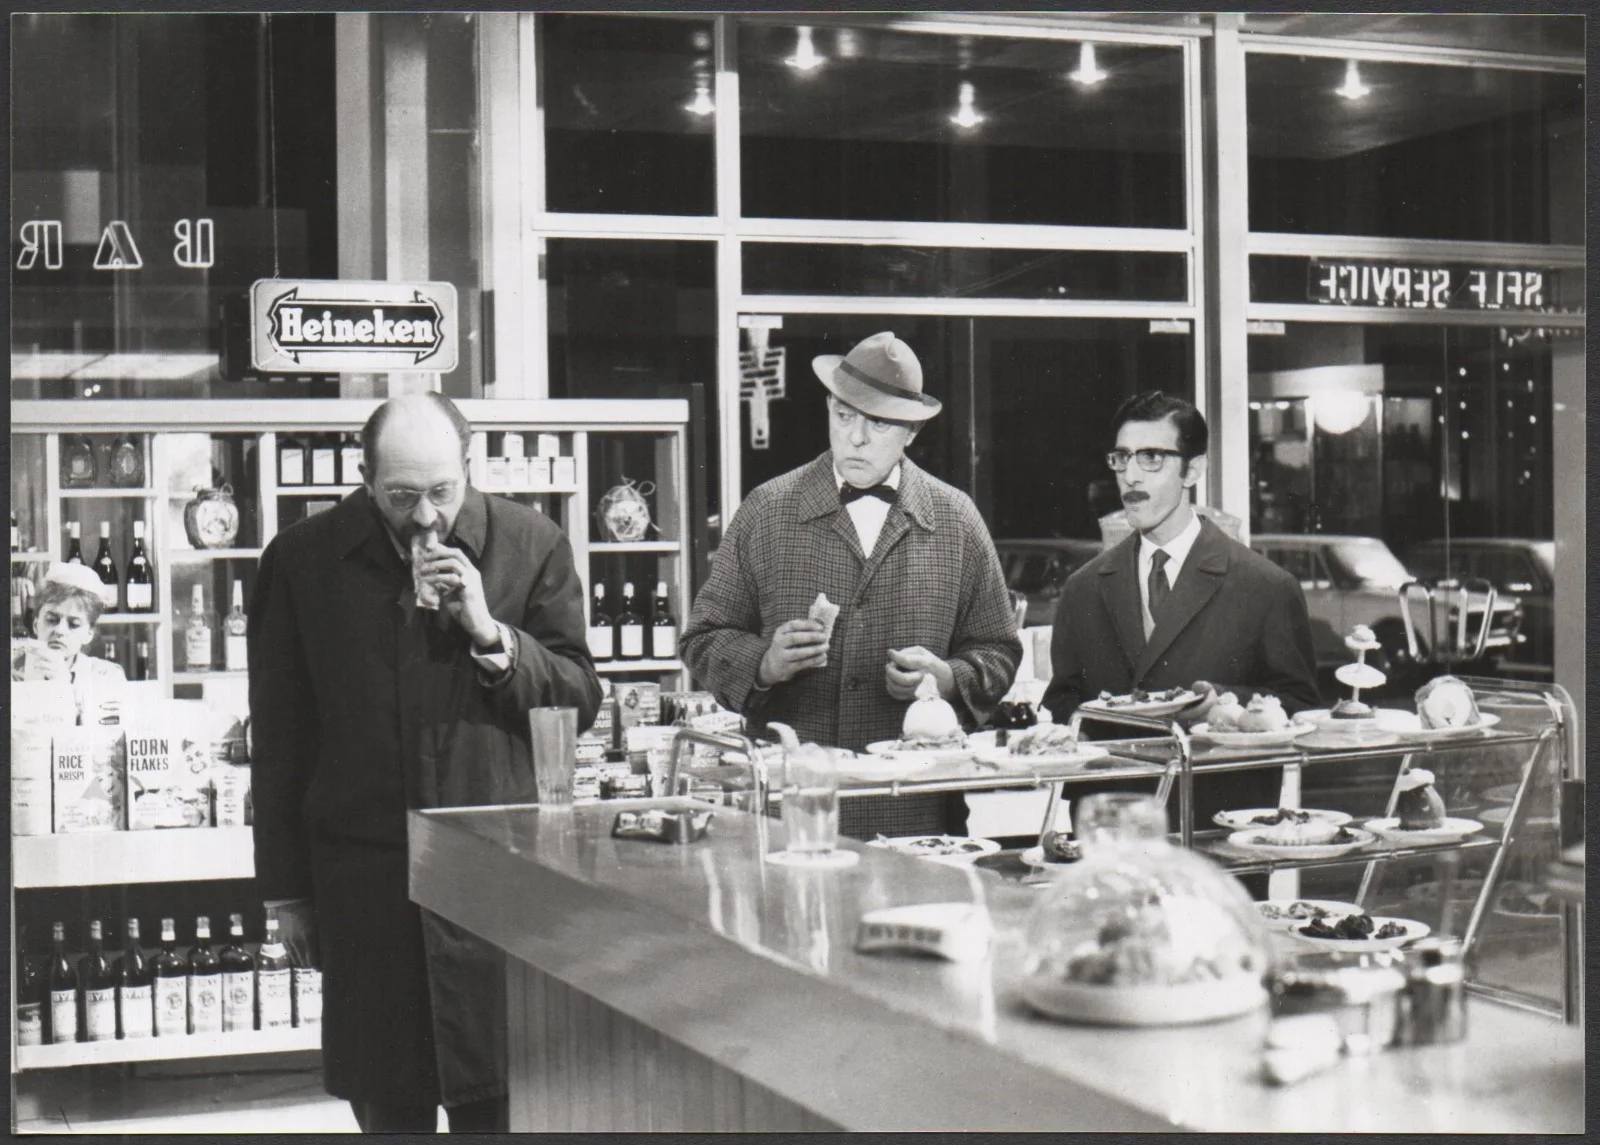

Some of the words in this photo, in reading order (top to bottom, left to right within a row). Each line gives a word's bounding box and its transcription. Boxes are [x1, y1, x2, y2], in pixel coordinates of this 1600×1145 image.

[279, 307, 436, 343] Heineken
[130, 738, 169, 756] CORN
[58, 754, 85, 769] RICE
[130, 757, 169, 772] FLAKES
